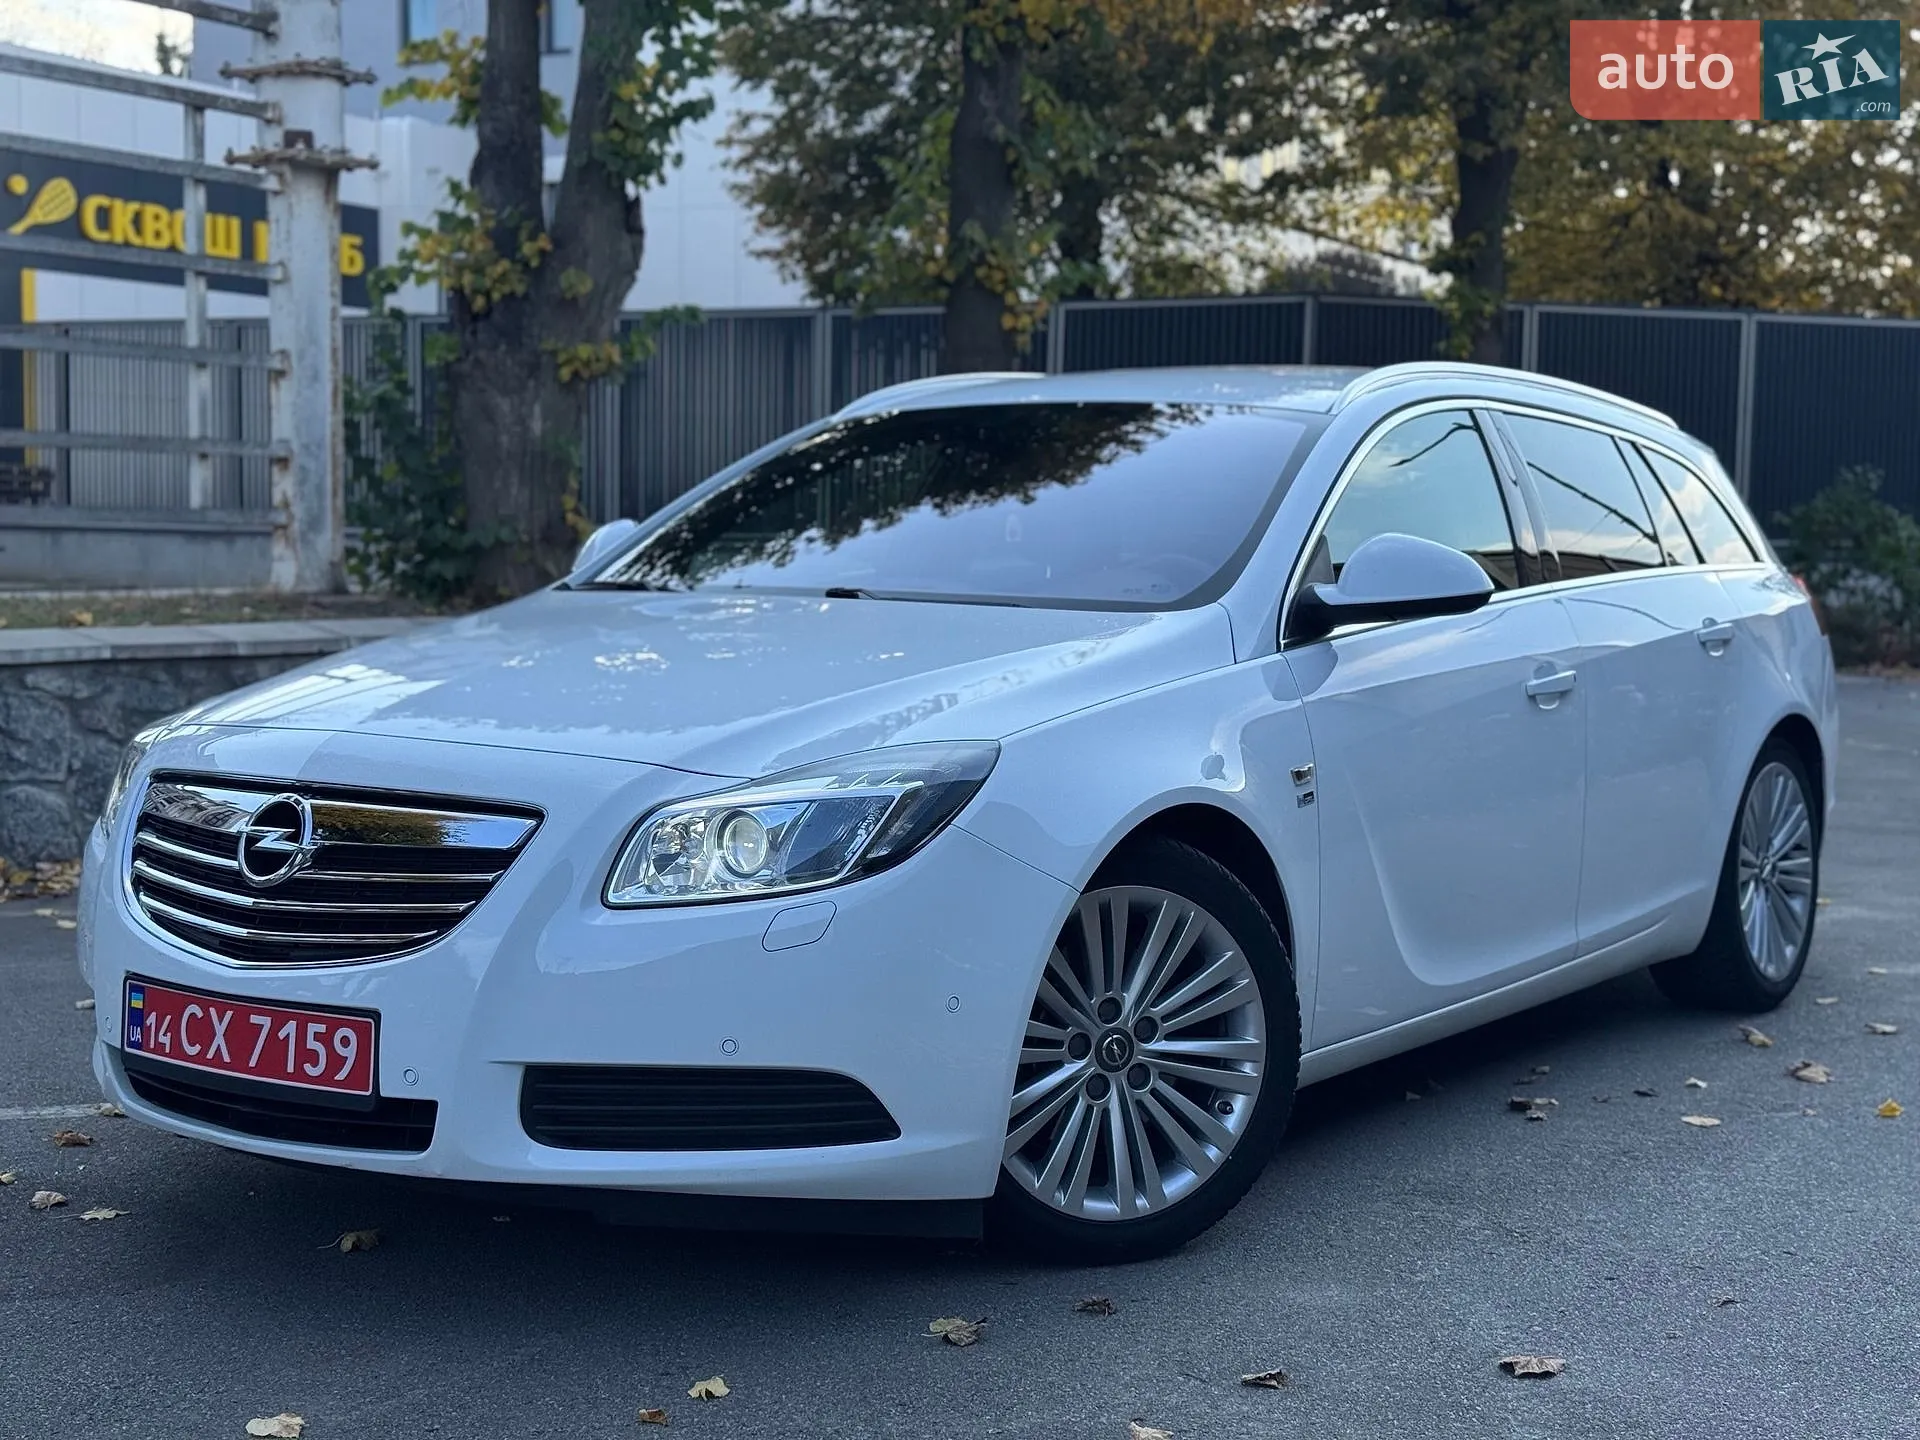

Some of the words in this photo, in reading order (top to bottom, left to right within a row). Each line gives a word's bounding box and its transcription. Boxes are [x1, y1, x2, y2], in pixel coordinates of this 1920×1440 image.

[130, 1024, 142, 1043] UA
[146, 1011, 172, 1054] 14
[180, 1004, 234, 1063] CX
[248, 1014, 358, 1081] 7159
